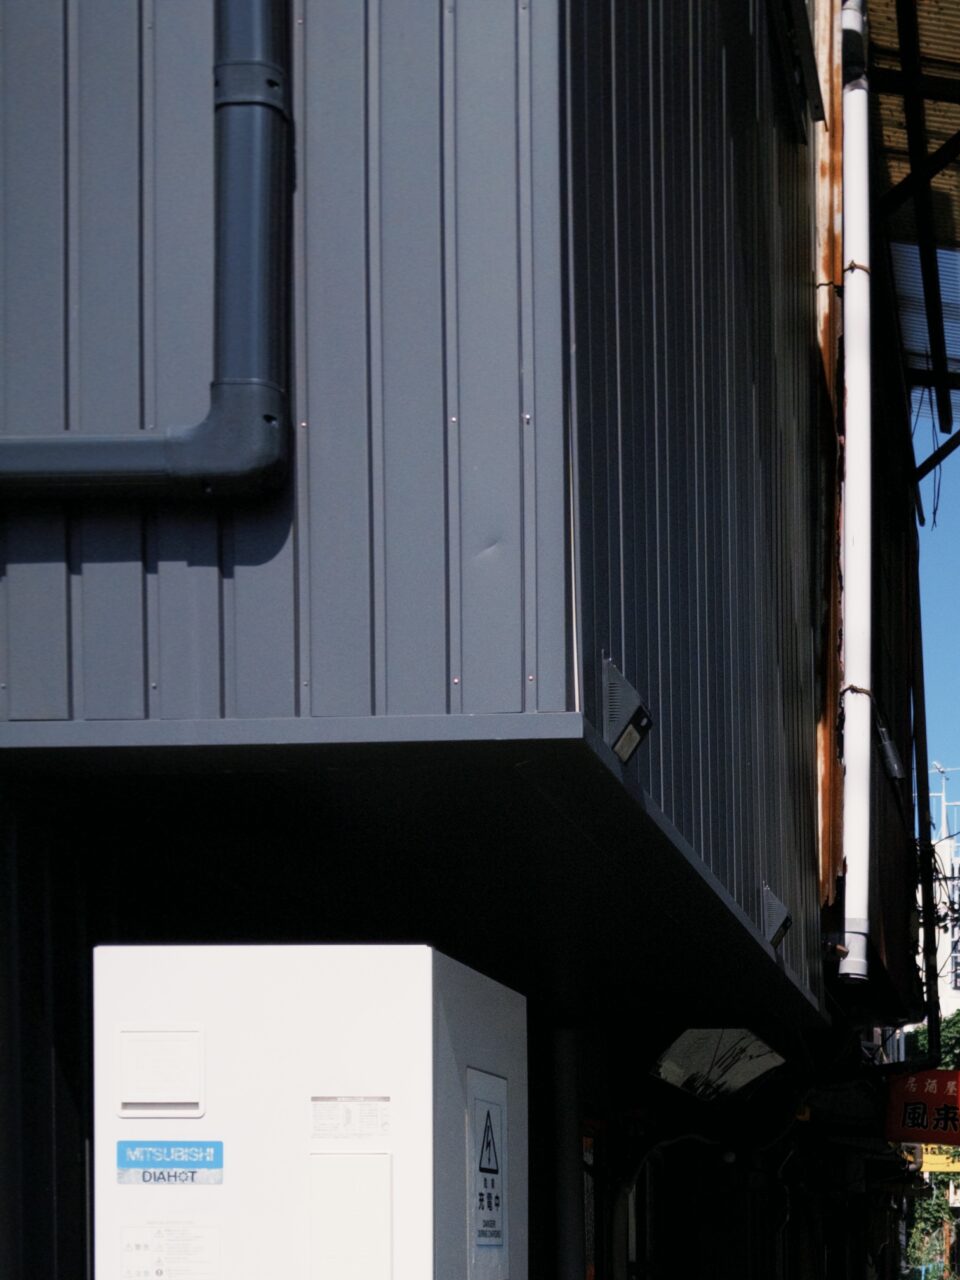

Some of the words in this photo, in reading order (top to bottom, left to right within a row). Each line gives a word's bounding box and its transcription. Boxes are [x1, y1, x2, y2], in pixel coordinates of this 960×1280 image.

[905, 1076, 958, 1096] 居酒屋
[126, 1147, 214, 1162] MITSUBISHI
